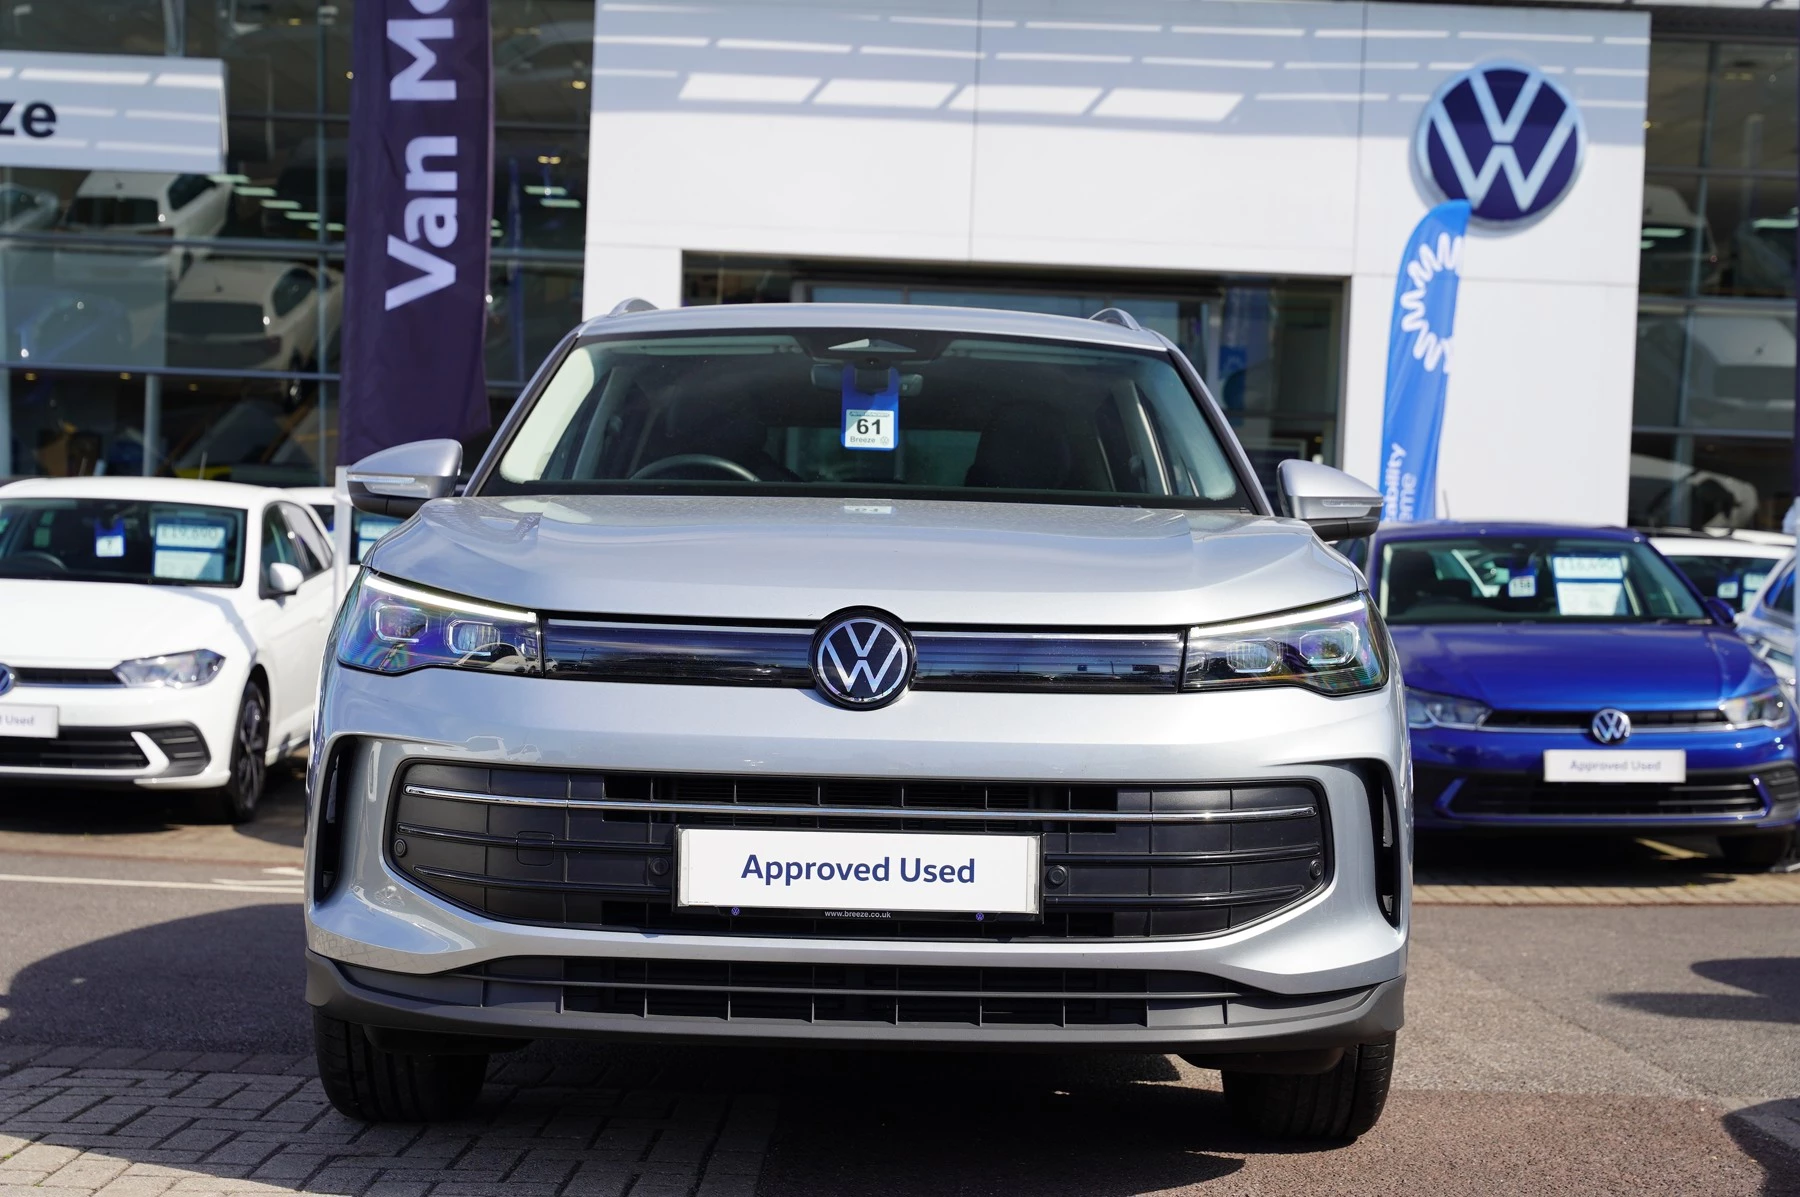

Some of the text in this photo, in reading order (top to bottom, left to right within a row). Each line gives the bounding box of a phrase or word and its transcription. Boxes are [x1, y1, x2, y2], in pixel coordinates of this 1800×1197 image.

[385, 136, 457, 310] Van
[856, 418, 881, 435] 61
[849, 436, 876, 444] Breeze
[1570, 760, 1661, 772] Approved Used
[741, 854, 975, 886] Approved Used
[824, 910, 891, 919] www.breeze.co.uk
